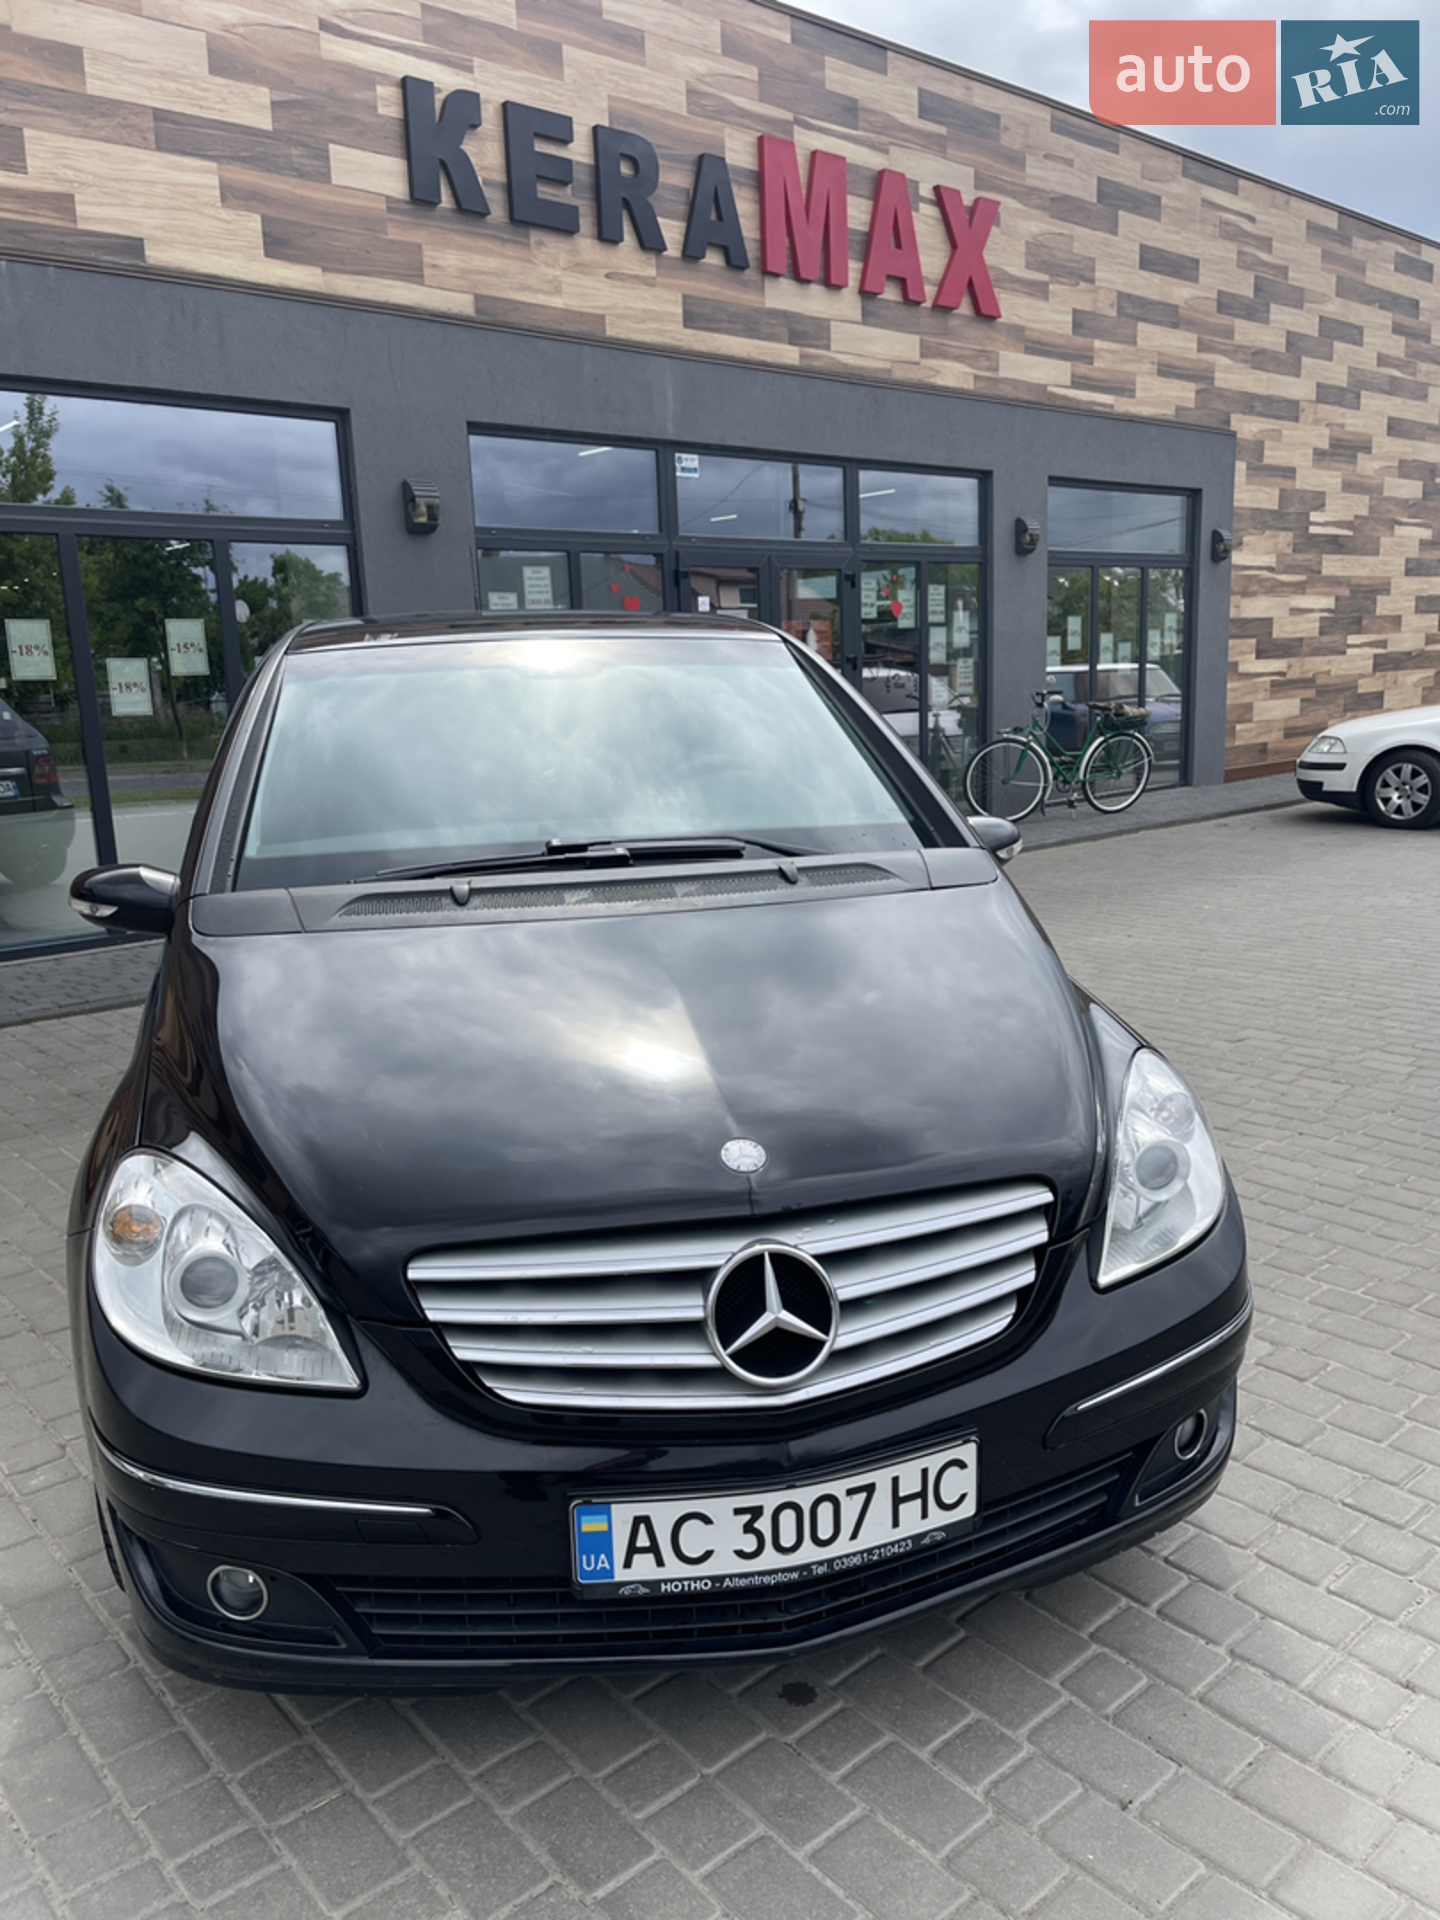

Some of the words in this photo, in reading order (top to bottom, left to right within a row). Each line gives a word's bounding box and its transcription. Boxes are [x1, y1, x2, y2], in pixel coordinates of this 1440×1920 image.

[401, 75, 1002, 319] KERAMAX
[12, 644, 50, 657] -18%
[171, 642, 204, 654] -15%
[112, 682, 147, 694] -18%
[622, 1511, 716, 1570] AC
[732, 1482, 877, 1561] 3007
[891, 1457, 969, 1530] HC
[582, 1554, 611, 1572] UA
[660, 1578, 712, 1594] HOTHO
[722, 1569, 800, 1589] Altentreptow
[811, 1561, 831, 1577] Tel.
[833, 1539, 913, 1571] 03961-210423
